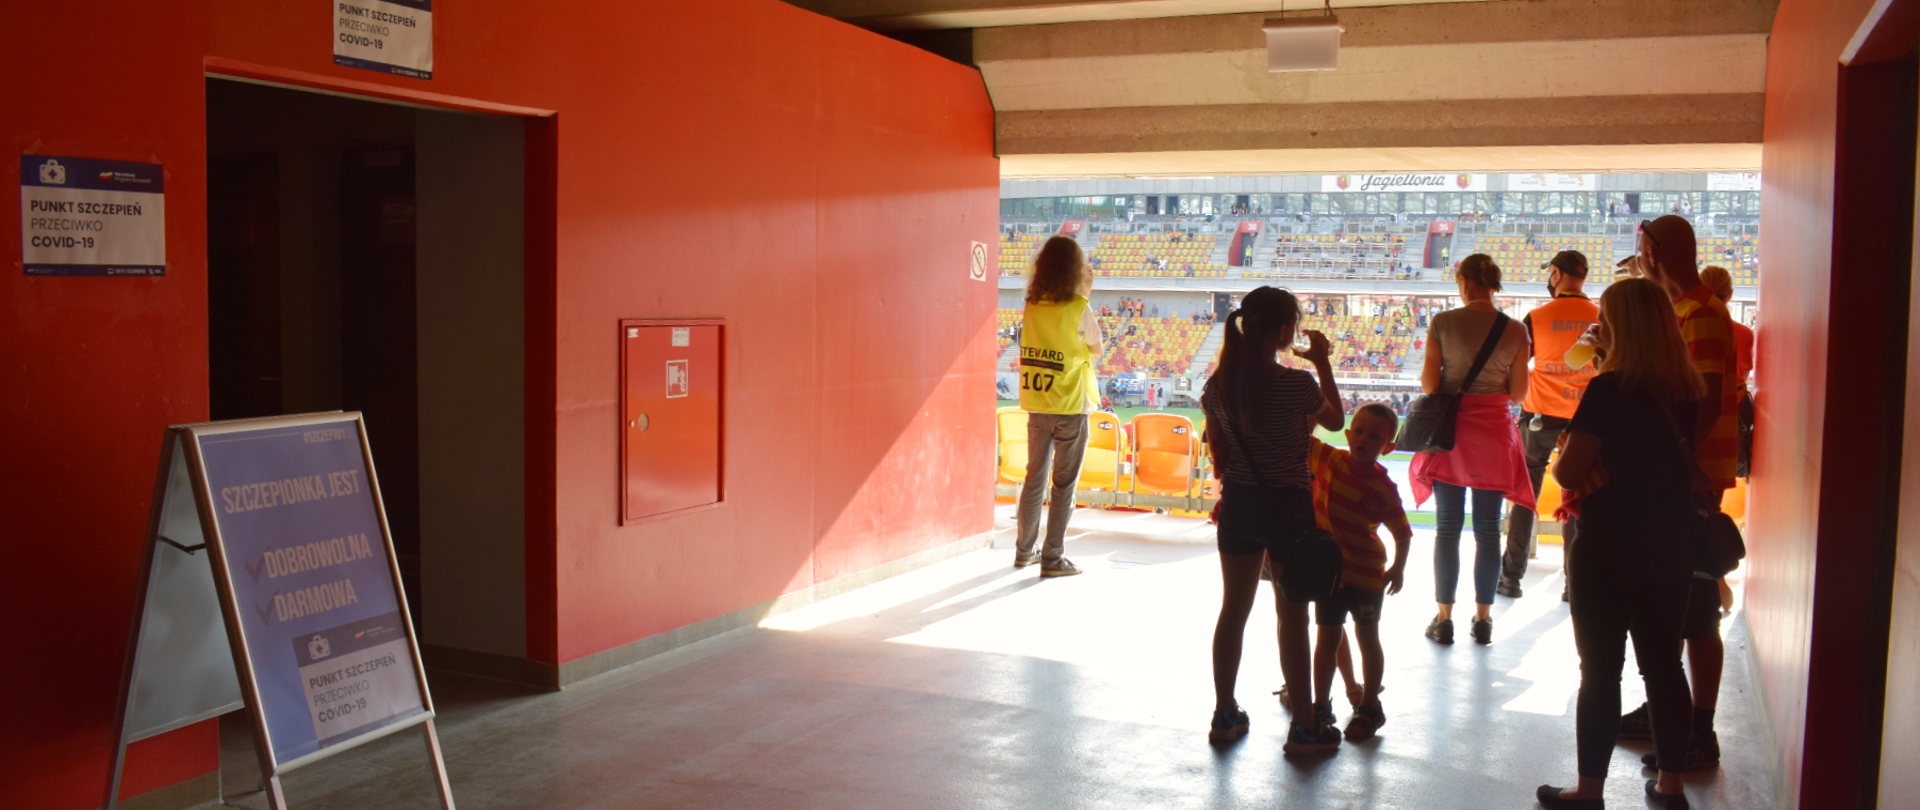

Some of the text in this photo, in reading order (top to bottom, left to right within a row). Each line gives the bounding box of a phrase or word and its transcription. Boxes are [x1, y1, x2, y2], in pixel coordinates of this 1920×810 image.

[339, 3, 416, 28] PUNKT SZCZEPIEŃ
[339, 17, 390, 36] PRZECIWKO
[339, 32, 383, 50] COVID-19
[1361, 174, 1446, 191] Jagiellonia
[30, 200, 142, 216] PUNKT SZCZEPIEŃ
[31, 218, 103, 232] PRZECIWKO
[1438, 223, 1449, 231] 35
[31, 236, 95, 248] COVID-19
[1552, 320, 1595, 332] MATP
[1022, 371, 1055, 392] 107
[221, 469, 360, 515] SZCZEPIONKA JEST
[264, 533, 373, 579] DOBROWOLNA
[274, 578, 358, 622] DARMOWA
[309, 652, 396, 689] PUNKT SZCZEPIEŃ
[313, 680, 370, 707] PRZECIWKO
[318, 698, 367, 723] COVID-19
